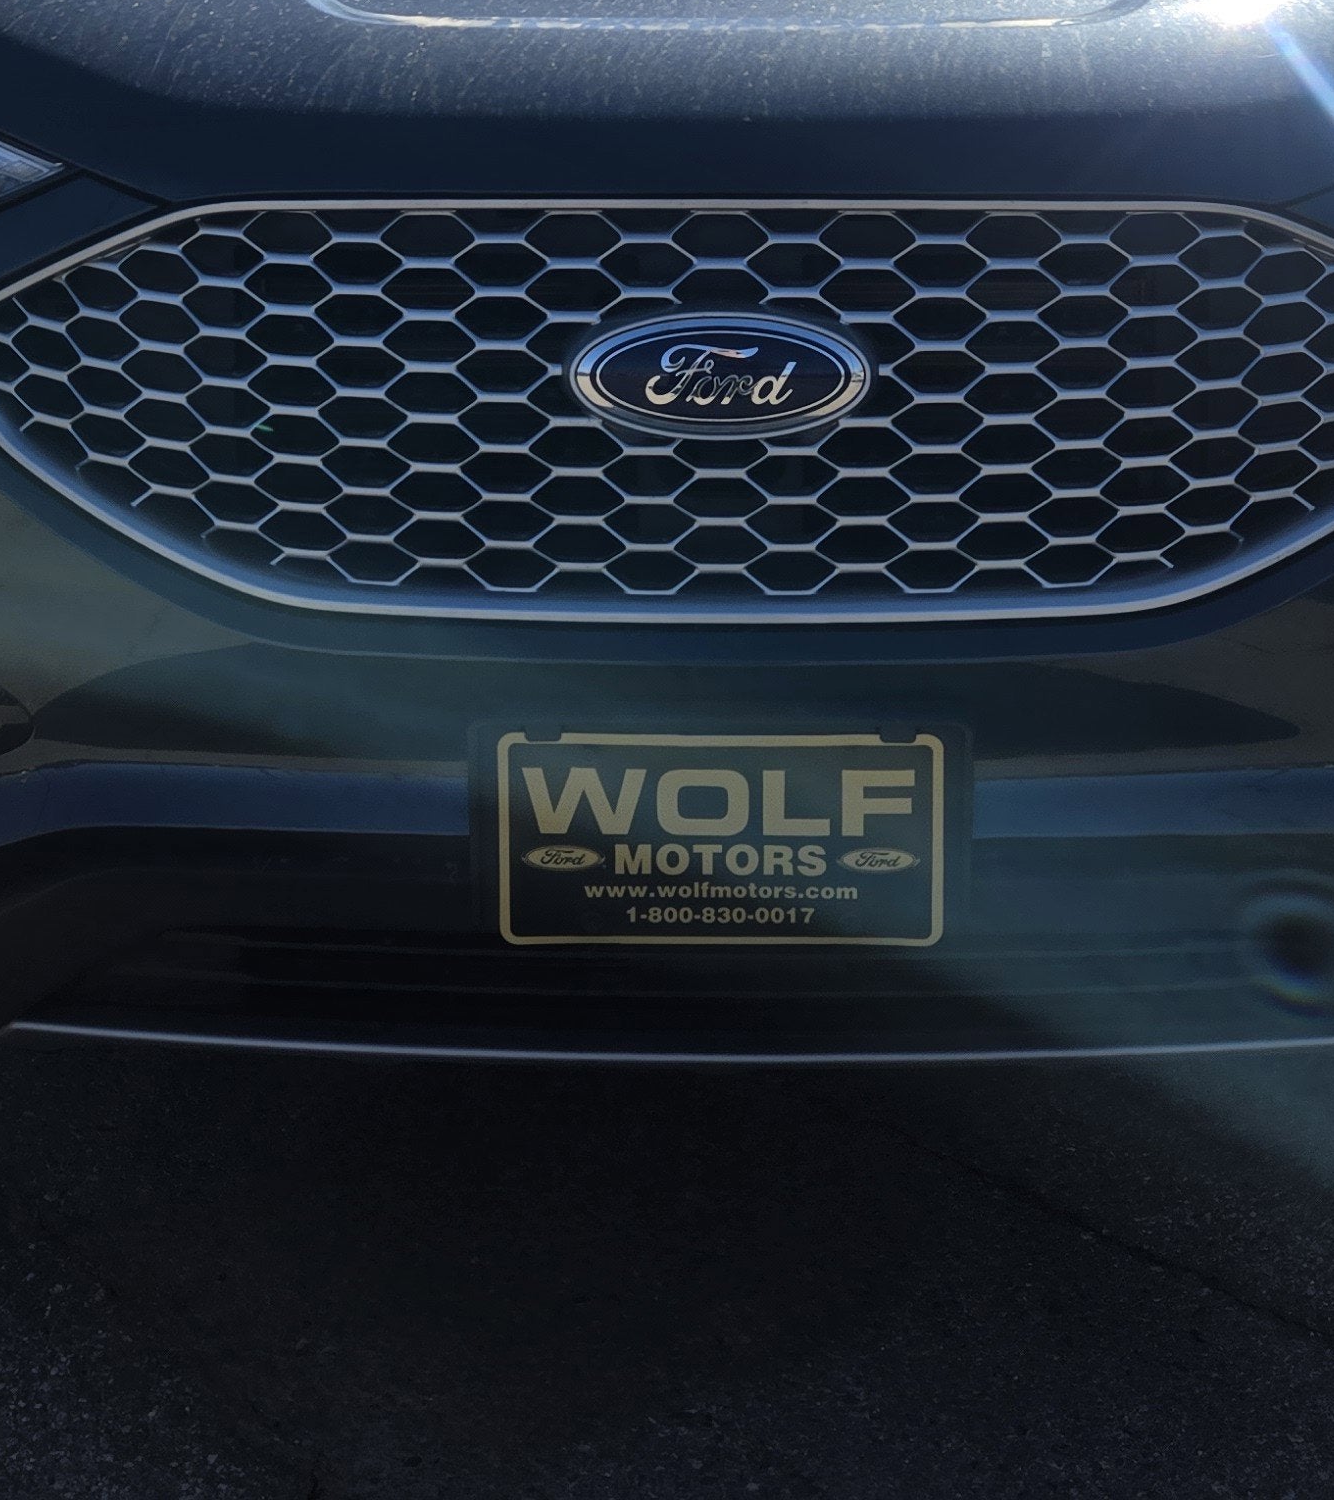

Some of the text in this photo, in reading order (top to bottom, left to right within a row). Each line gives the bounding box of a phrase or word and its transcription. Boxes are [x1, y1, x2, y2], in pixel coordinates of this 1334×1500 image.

[645, 344, 797, 405] Ford
[522, 766, 916, 837] WOLF
[540, 843, 901, 877] Ford MOTORS Ford
[584, 881, 859, 901] www.wolfmotors.com
[626, 906, 816, 925] 1-800-830-0017
